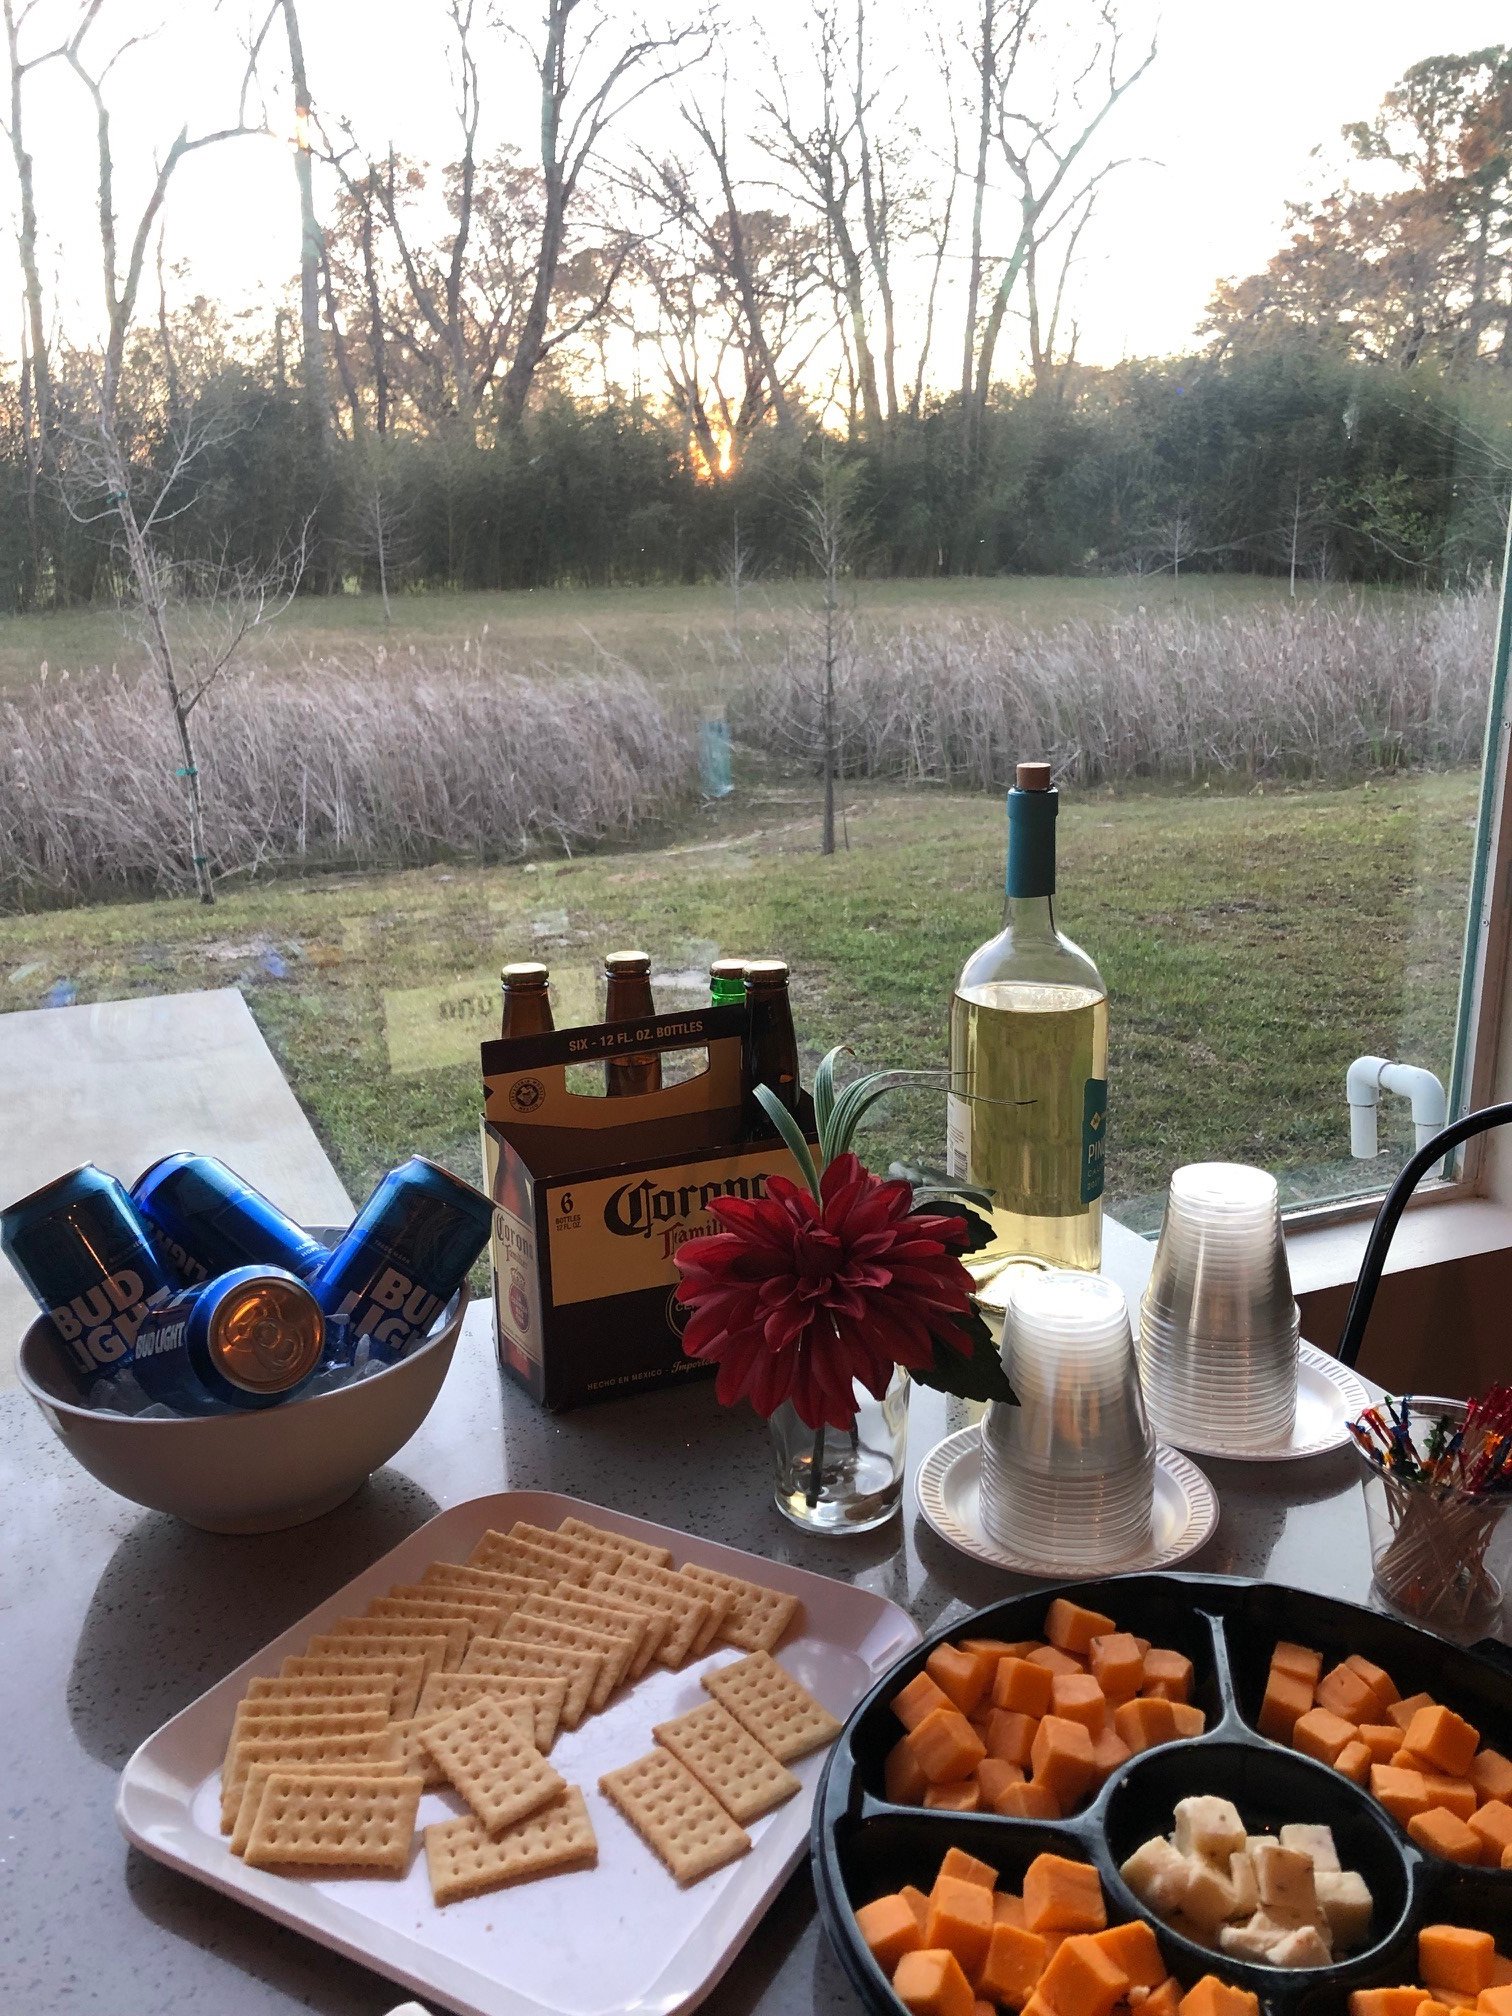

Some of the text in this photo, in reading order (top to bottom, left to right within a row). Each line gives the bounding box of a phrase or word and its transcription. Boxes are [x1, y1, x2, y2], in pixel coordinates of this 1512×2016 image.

[569, 1039, 588, 1052] SIX
[600, 1034, 615, 1047] 12
[617, 1033, 634, 1044] FL.
[636, 1029, 654, 1041] OZ.
[656, 1021, 704, 1038] BOTTLES
[561, 1192, 574, 1214] 6
[555, 1214, 581, 1225] BOTTLES
[50, 1269, 144, 1341] BUD
[135, 1321, 186, 1359] BUD LIGHT
[587, 1378, 616, 1391] HECHO
[618, 1374, 630, 1384] EN
[631, 1368, 663, 1382] MEXICO
